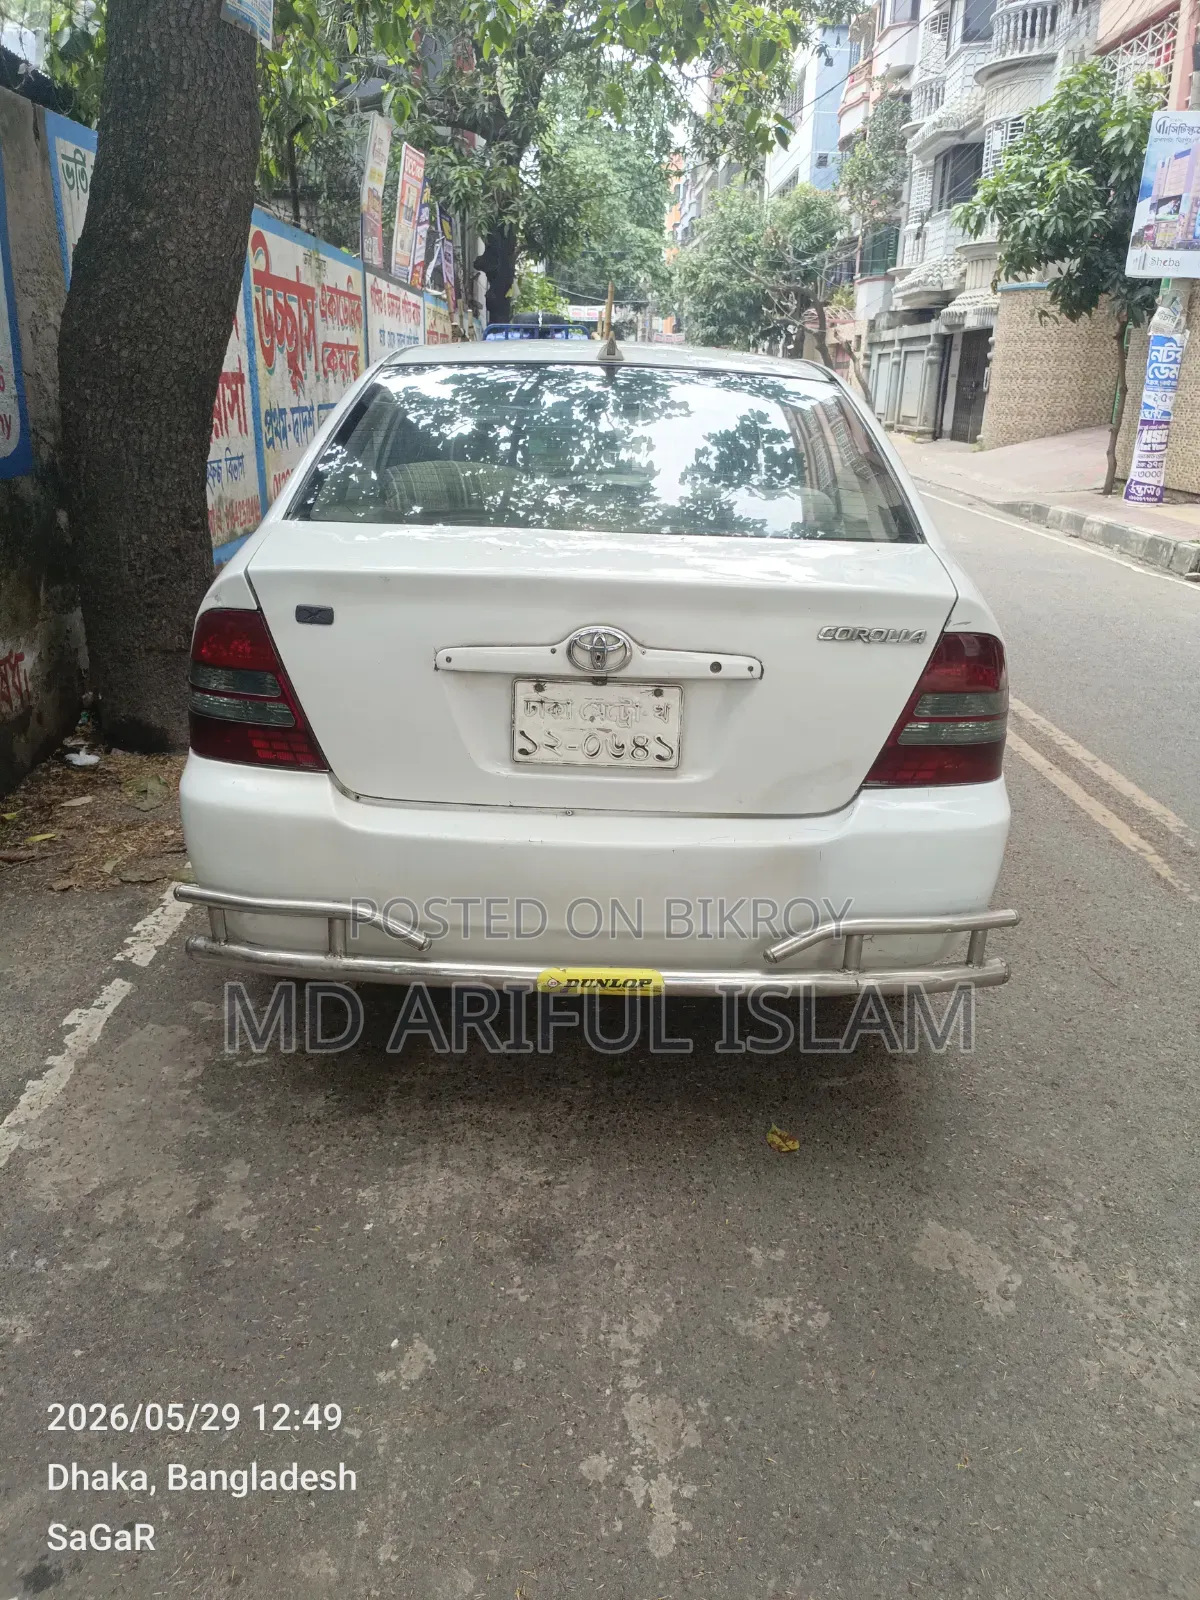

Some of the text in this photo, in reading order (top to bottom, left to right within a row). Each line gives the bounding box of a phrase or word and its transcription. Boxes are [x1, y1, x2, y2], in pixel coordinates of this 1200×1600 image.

[817, 626, 926, 643] COROLLA
[523, 698, 573, 720] ঢাকা
[564, 978, 652, 988] DUNLOP
